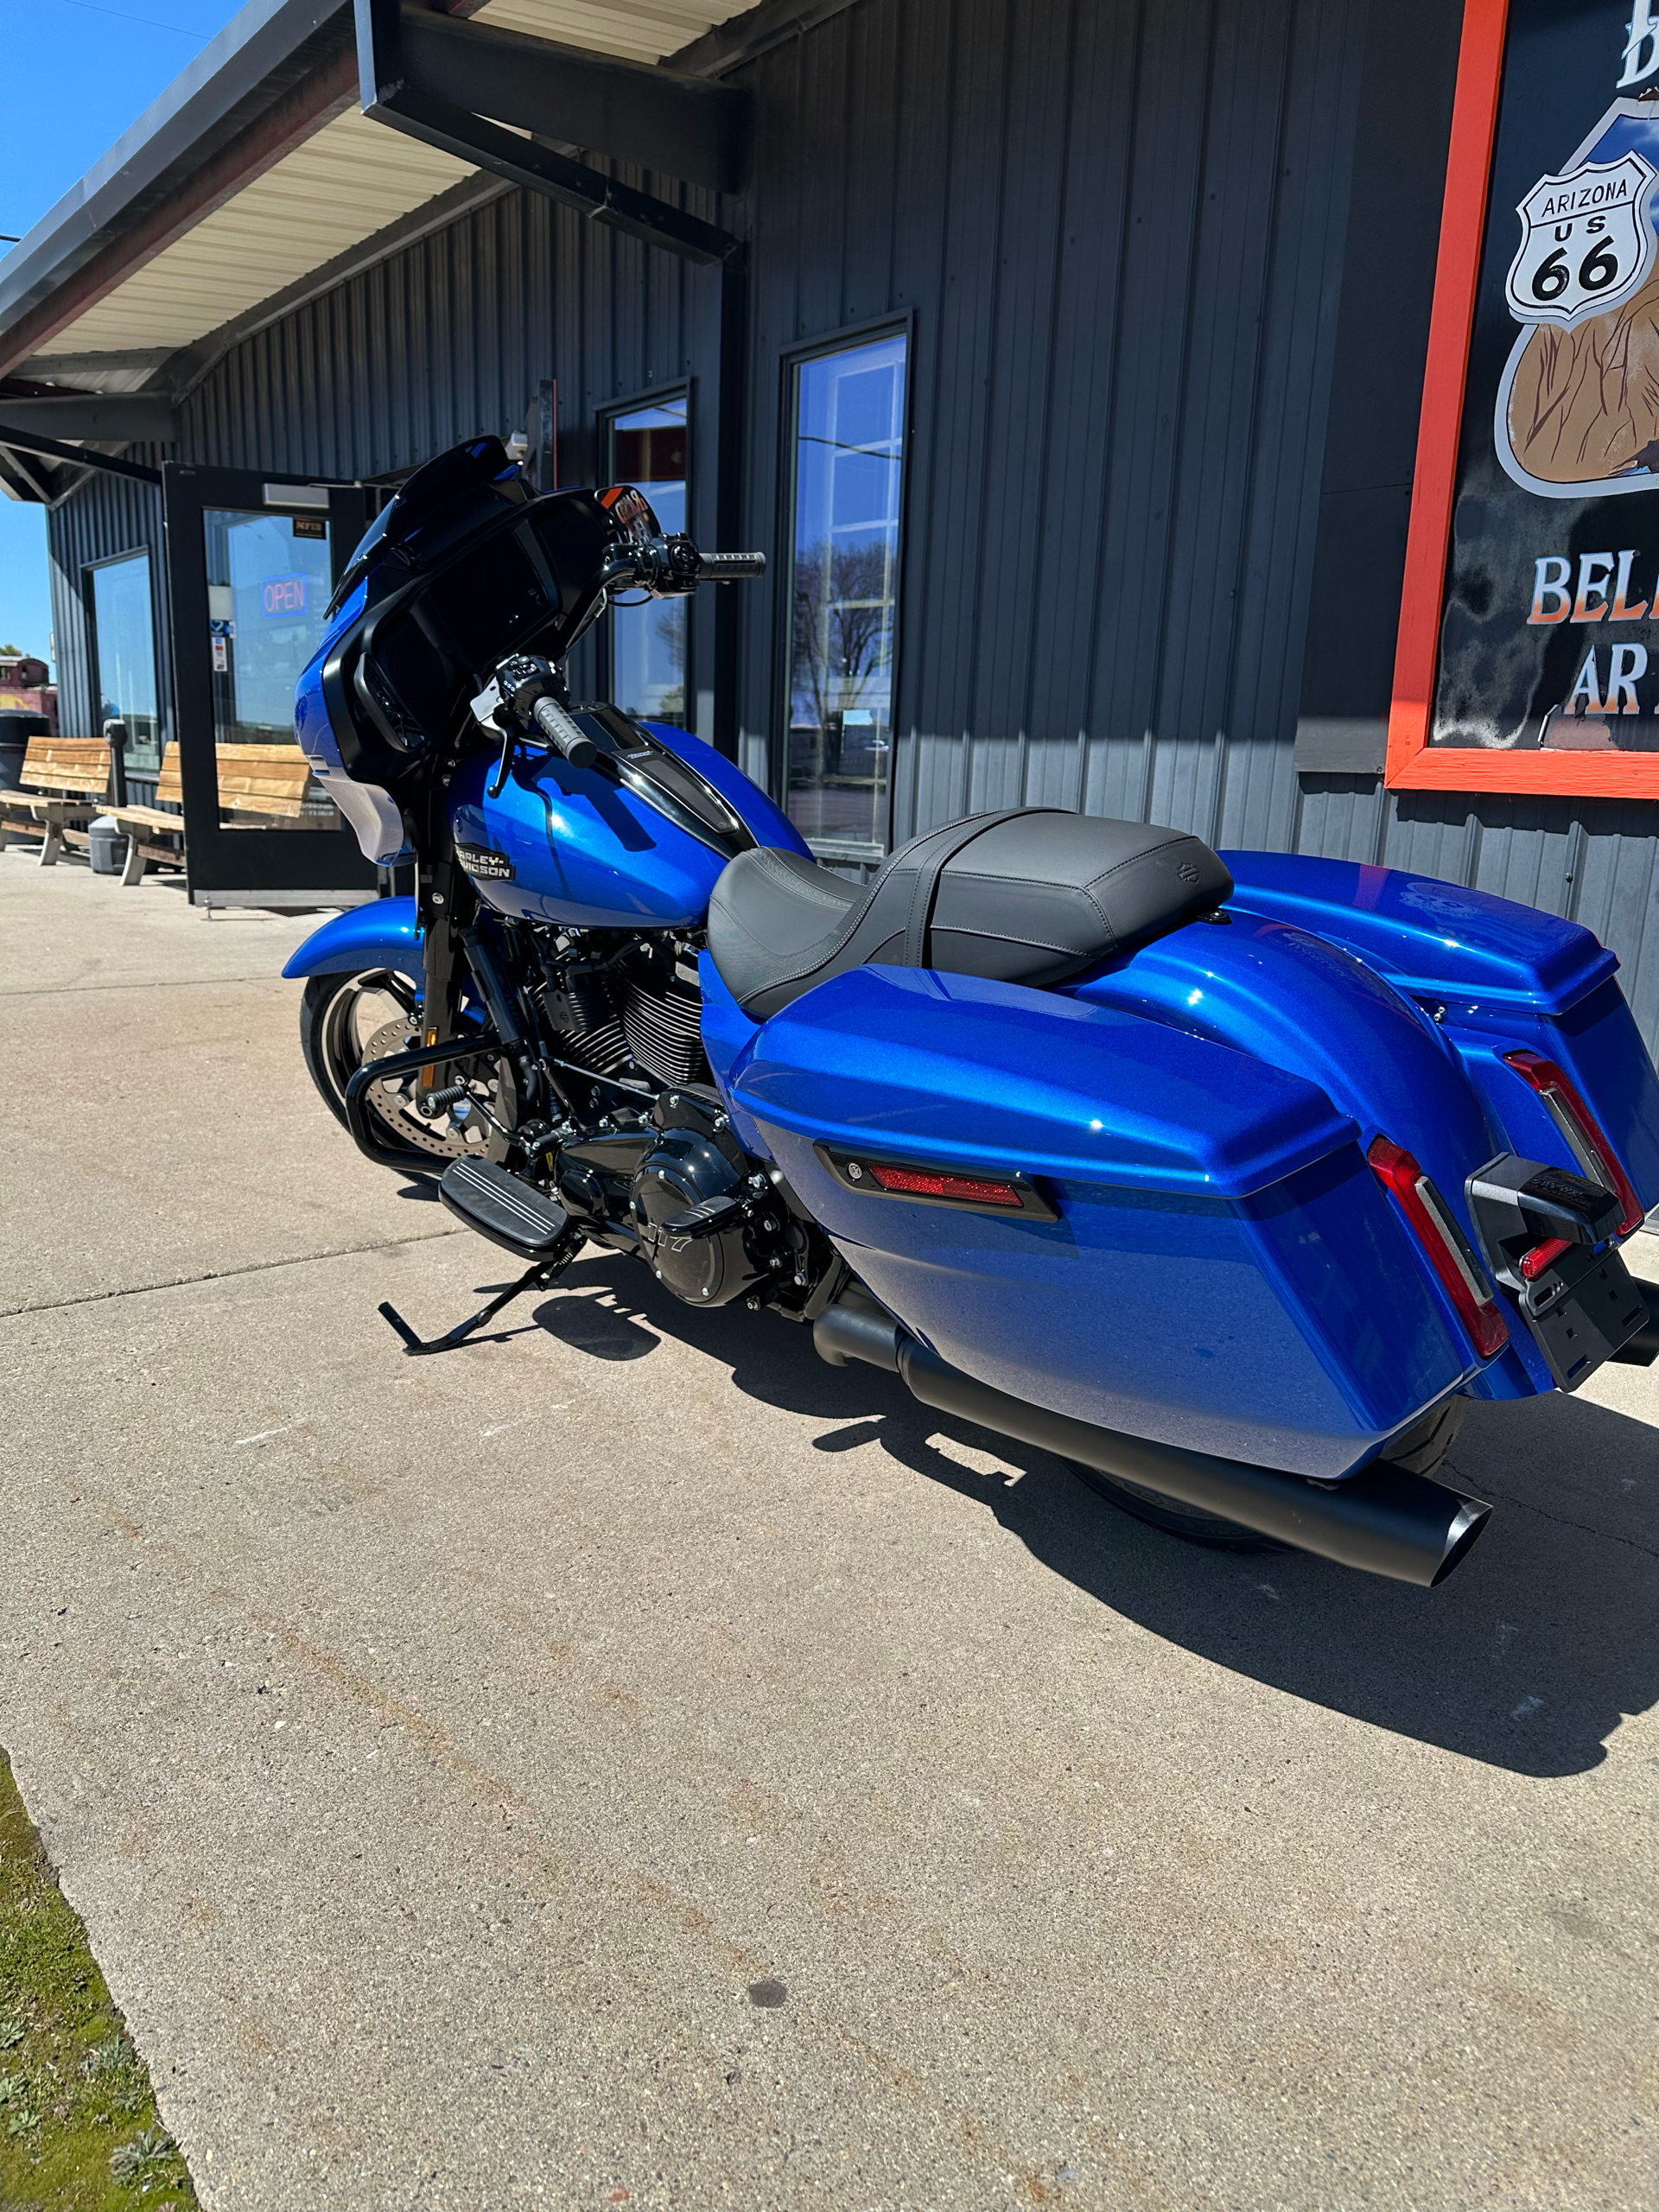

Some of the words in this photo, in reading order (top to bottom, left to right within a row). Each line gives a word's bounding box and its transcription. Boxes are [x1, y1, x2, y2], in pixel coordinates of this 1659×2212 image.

[1541, 179, 1627, 217] ARIZONA
[1532, 236, 1618, 301] 66
[265, 581, 304, 612] OPEN
[1563, 642, 1659, 715] AR
[648, 1223, 693, 1252] 117
